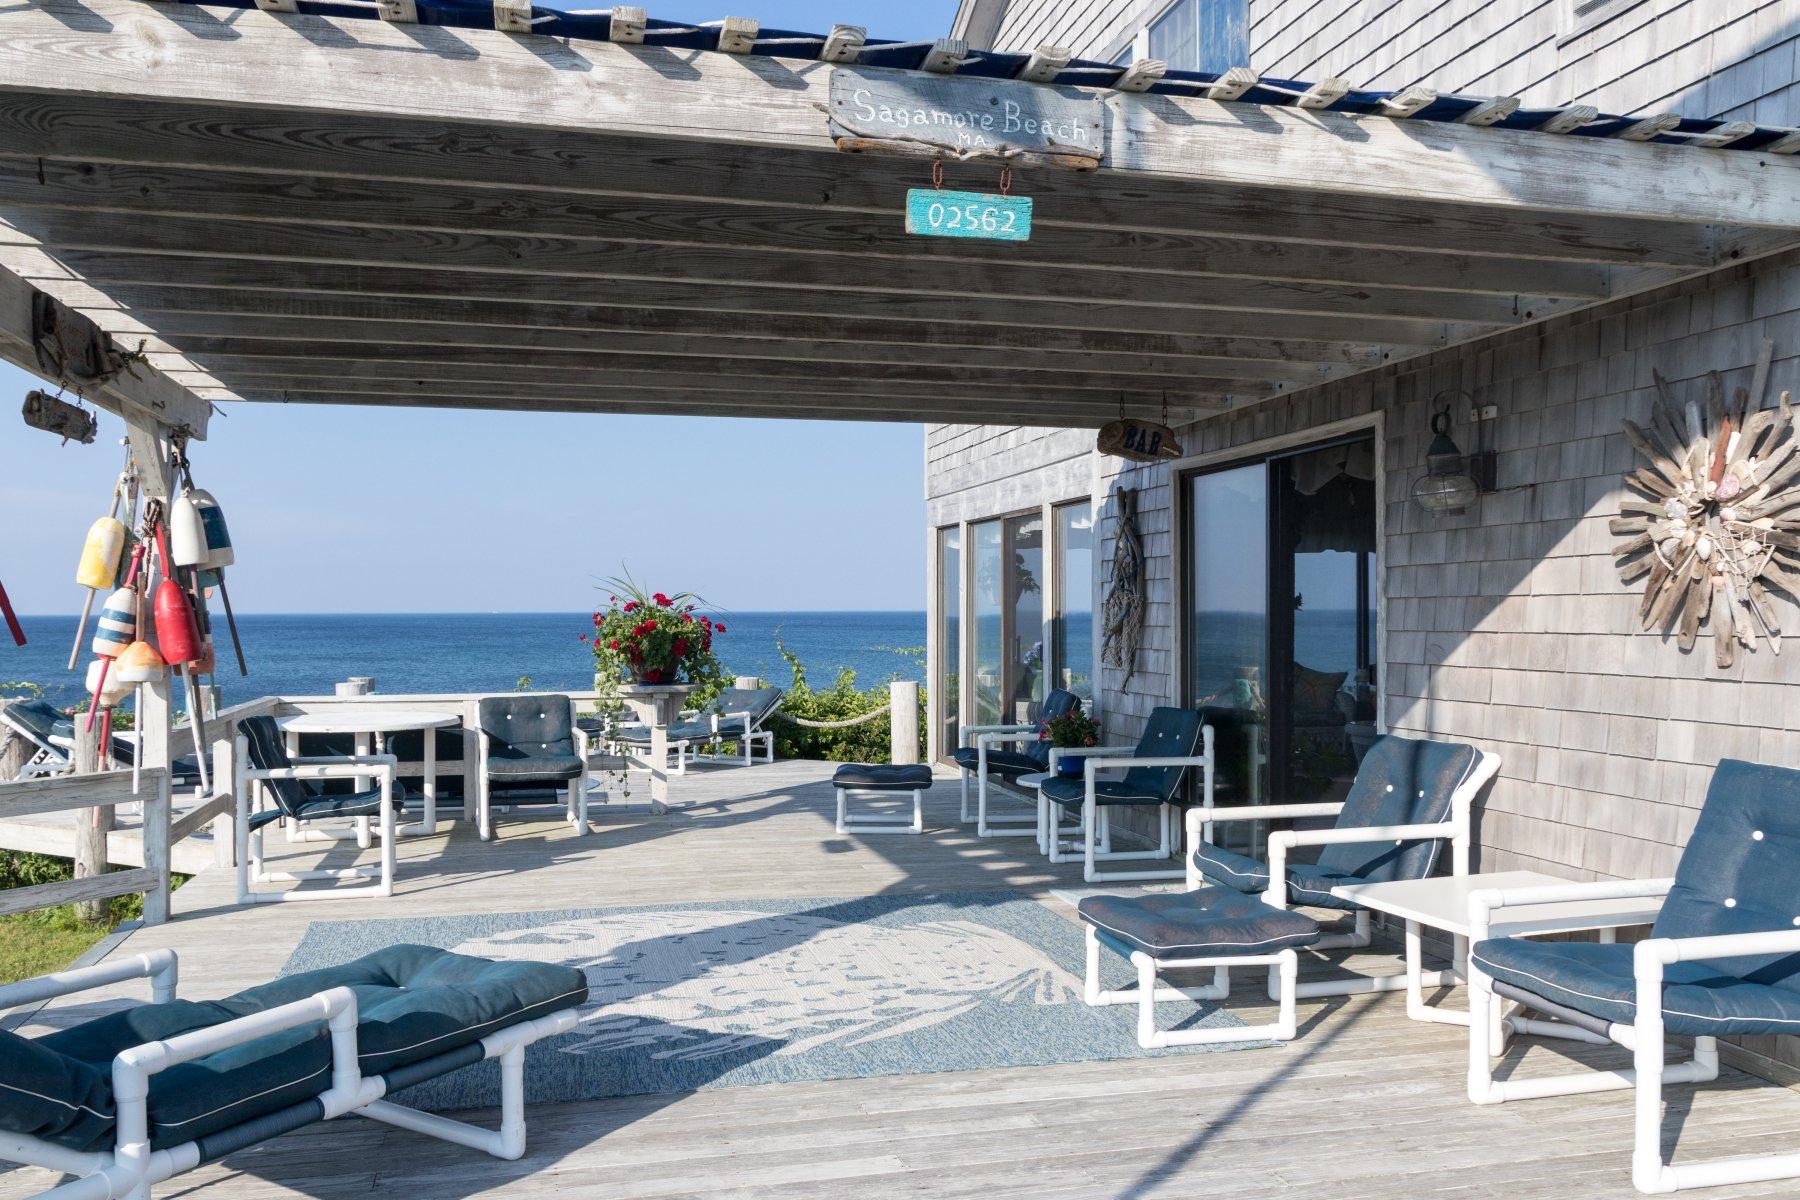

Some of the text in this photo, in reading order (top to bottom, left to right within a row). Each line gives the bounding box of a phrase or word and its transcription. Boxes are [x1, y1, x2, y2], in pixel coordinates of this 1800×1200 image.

[853, 88, 1086, 141] Sagamore Beach
[957, 132, 987, 147] MA
[928, 202, 1016, 233] 02562
[1123, 424, 1162, 456] BAR
